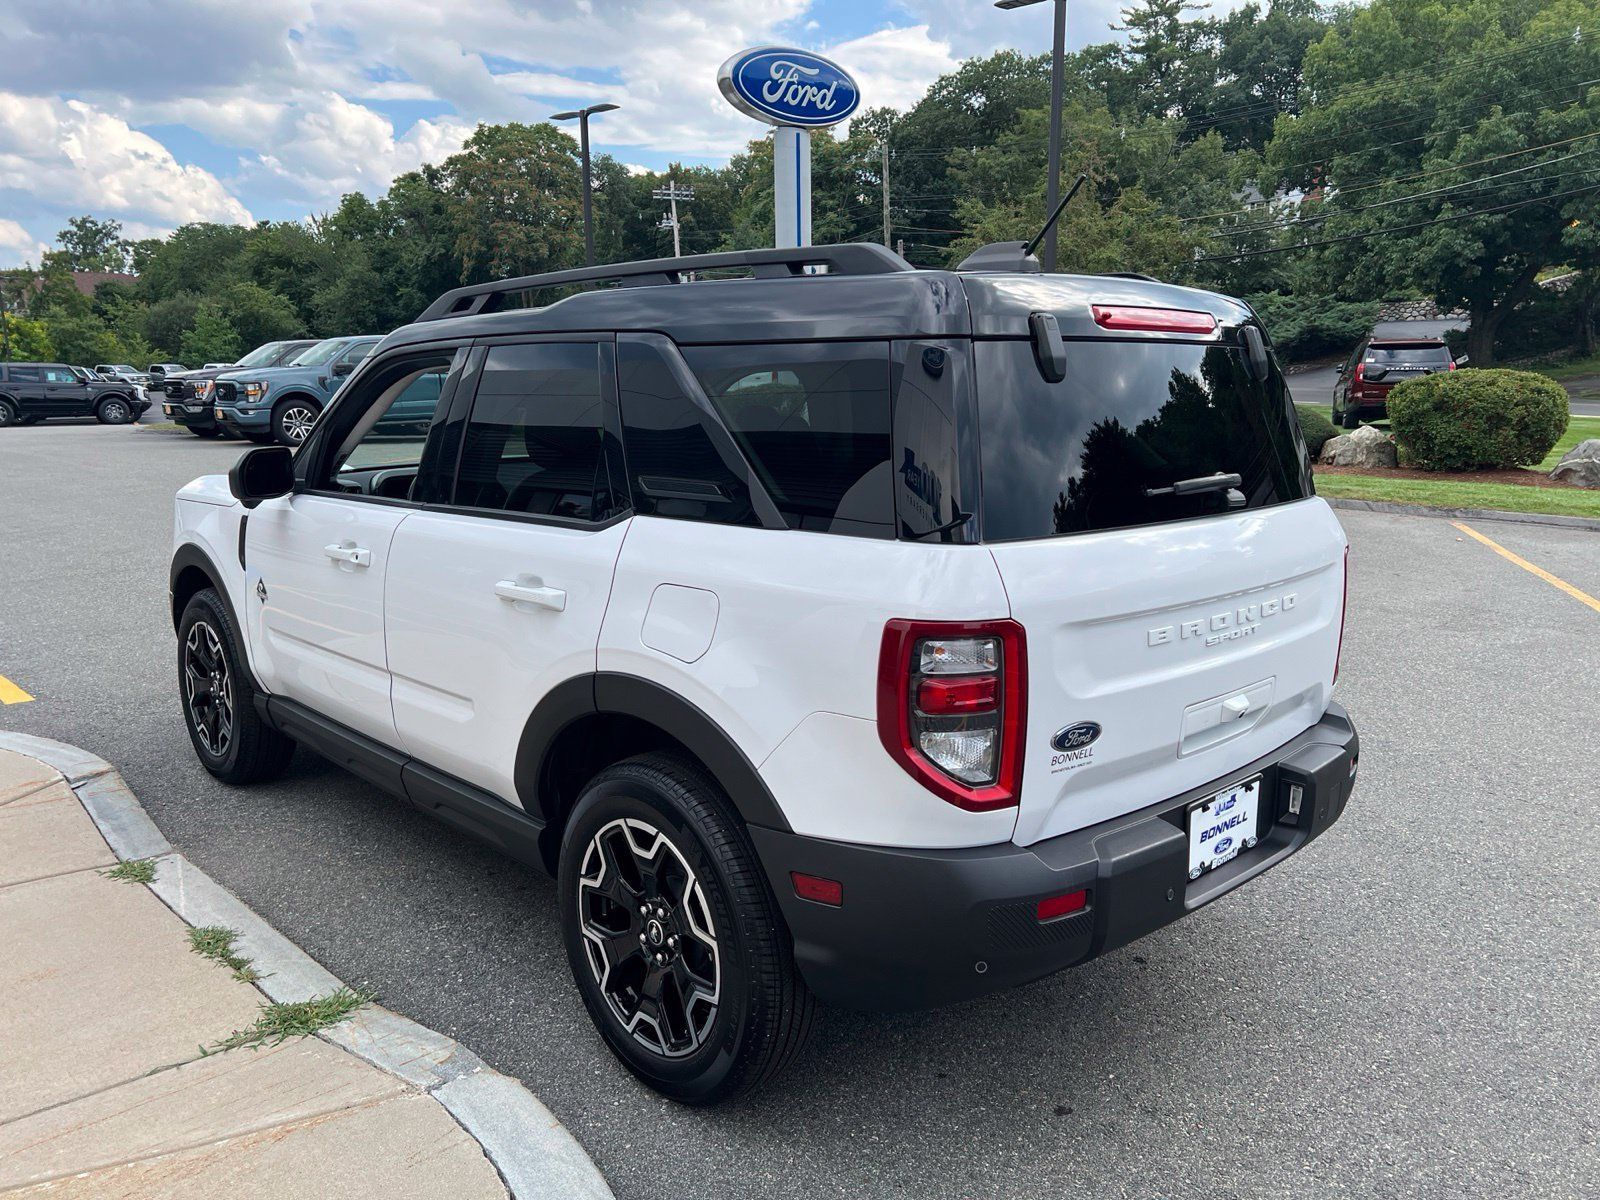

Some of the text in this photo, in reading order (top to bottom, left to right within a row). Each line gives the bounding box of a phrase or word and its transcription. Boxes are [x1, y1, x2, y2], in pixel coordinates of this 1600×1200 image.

[762, 60, 837, 111] Ford
[1148, 593, 1298, 647] BRONCO
[1205, 623, 1261, 647] SPORT
[1064, 728, 1093, 747] Ford
[1051, 747, 1094, 766] BONNELL
[1200, 811, 1248, 844] BONNELL
